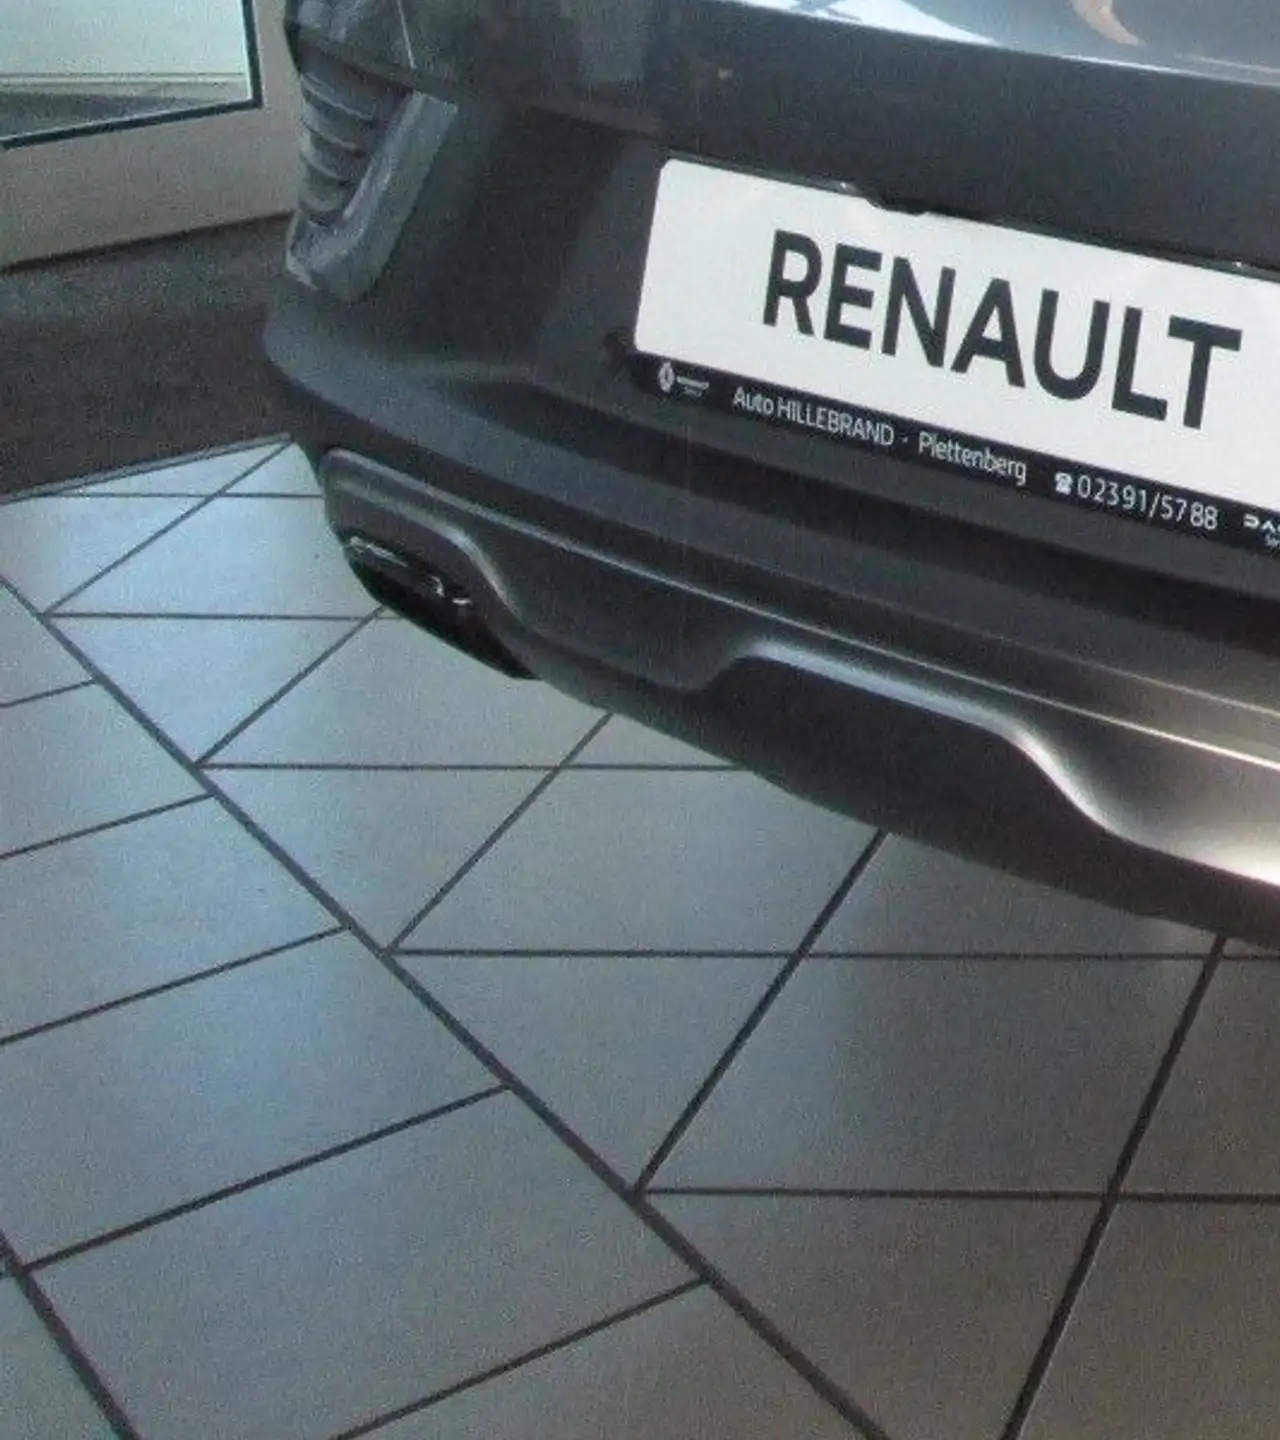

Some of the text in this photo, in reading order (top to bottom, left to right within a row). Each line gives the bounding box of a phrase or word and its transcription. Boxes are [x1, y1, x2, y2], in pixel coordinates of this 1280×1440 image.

[761, 228, 1244, 430] RENAULT
[732, 385, 1219, 531] Auto HILLEBRAND Plettenberg 02391/5788
